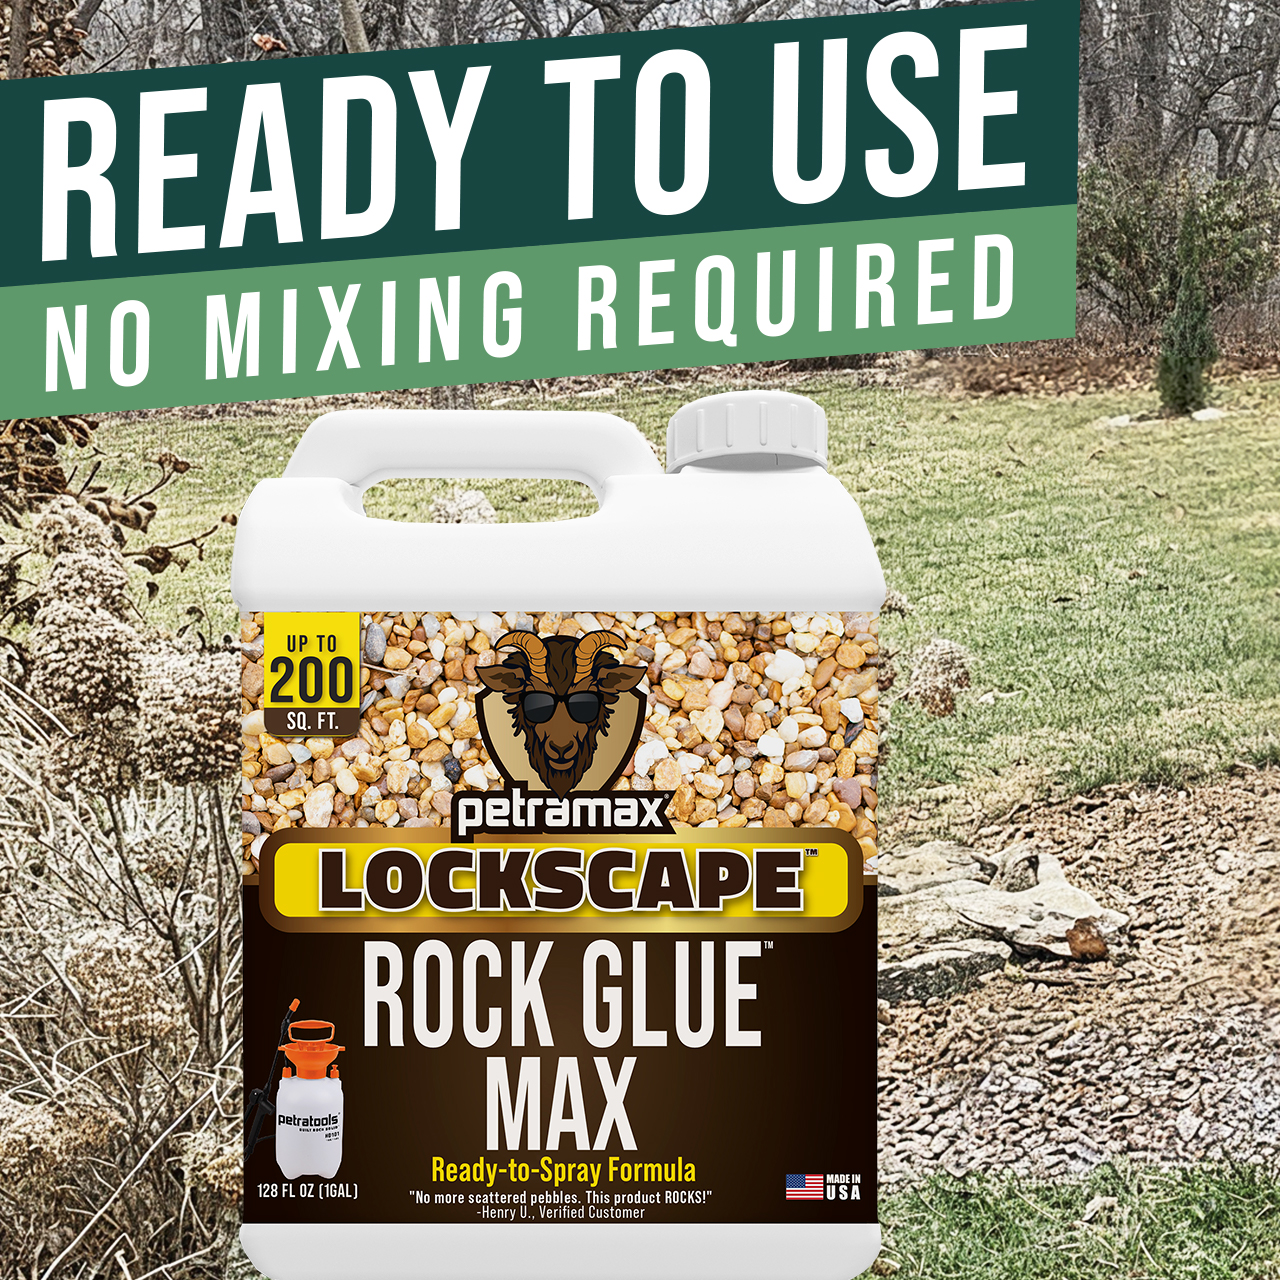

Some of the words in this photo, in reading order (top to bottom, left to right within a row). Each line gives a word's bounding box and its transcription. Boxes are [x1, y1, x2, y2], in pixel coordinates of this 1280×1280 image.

[287, 634, 308, 653] UP
[316, 634, 337, 653] TO
[270, 656, 353, 703] 200
[287, 711, 311, 730] SQ.
[318, 711, 339, 729] FT.
[364, 940, 554, 1048] ROCK
[486, 1056, 638, 1151] MAX
[278, 1114, 338, 1126] petratools
[432, 1156, 602, 1187] Ready-to-Spray
[608, 1156, 696, 1182] Formula
[826, 1173, 851, 1184] MADE
[852, 1173, 861, 1184] IN
[257, 1183, 278, 1198] 128
[282, 1183, 296, 1198] FL
[300, 1183, 315, 1198] OZ
[319, 1183, 358, 1200] (1GAL)
[409, 1190, 431, 1204] "No
[434, 1192, 465, 1204] more
[468, 1190, 527, 1204] scattered
[530, 1190, 582, 1205] pebbles.
[585, 1190, 611, 1204] This
[614, 1190, 661, 1206] product
[665, 1190, 713, 1204] ROCKS!"
[476, 1205, 517, 1222] -Henry
[520, 1205, 536, 1220] U.,
[539, 1204, 585, 1219] Verified
[588, 1204, 646, 1219] Customer
